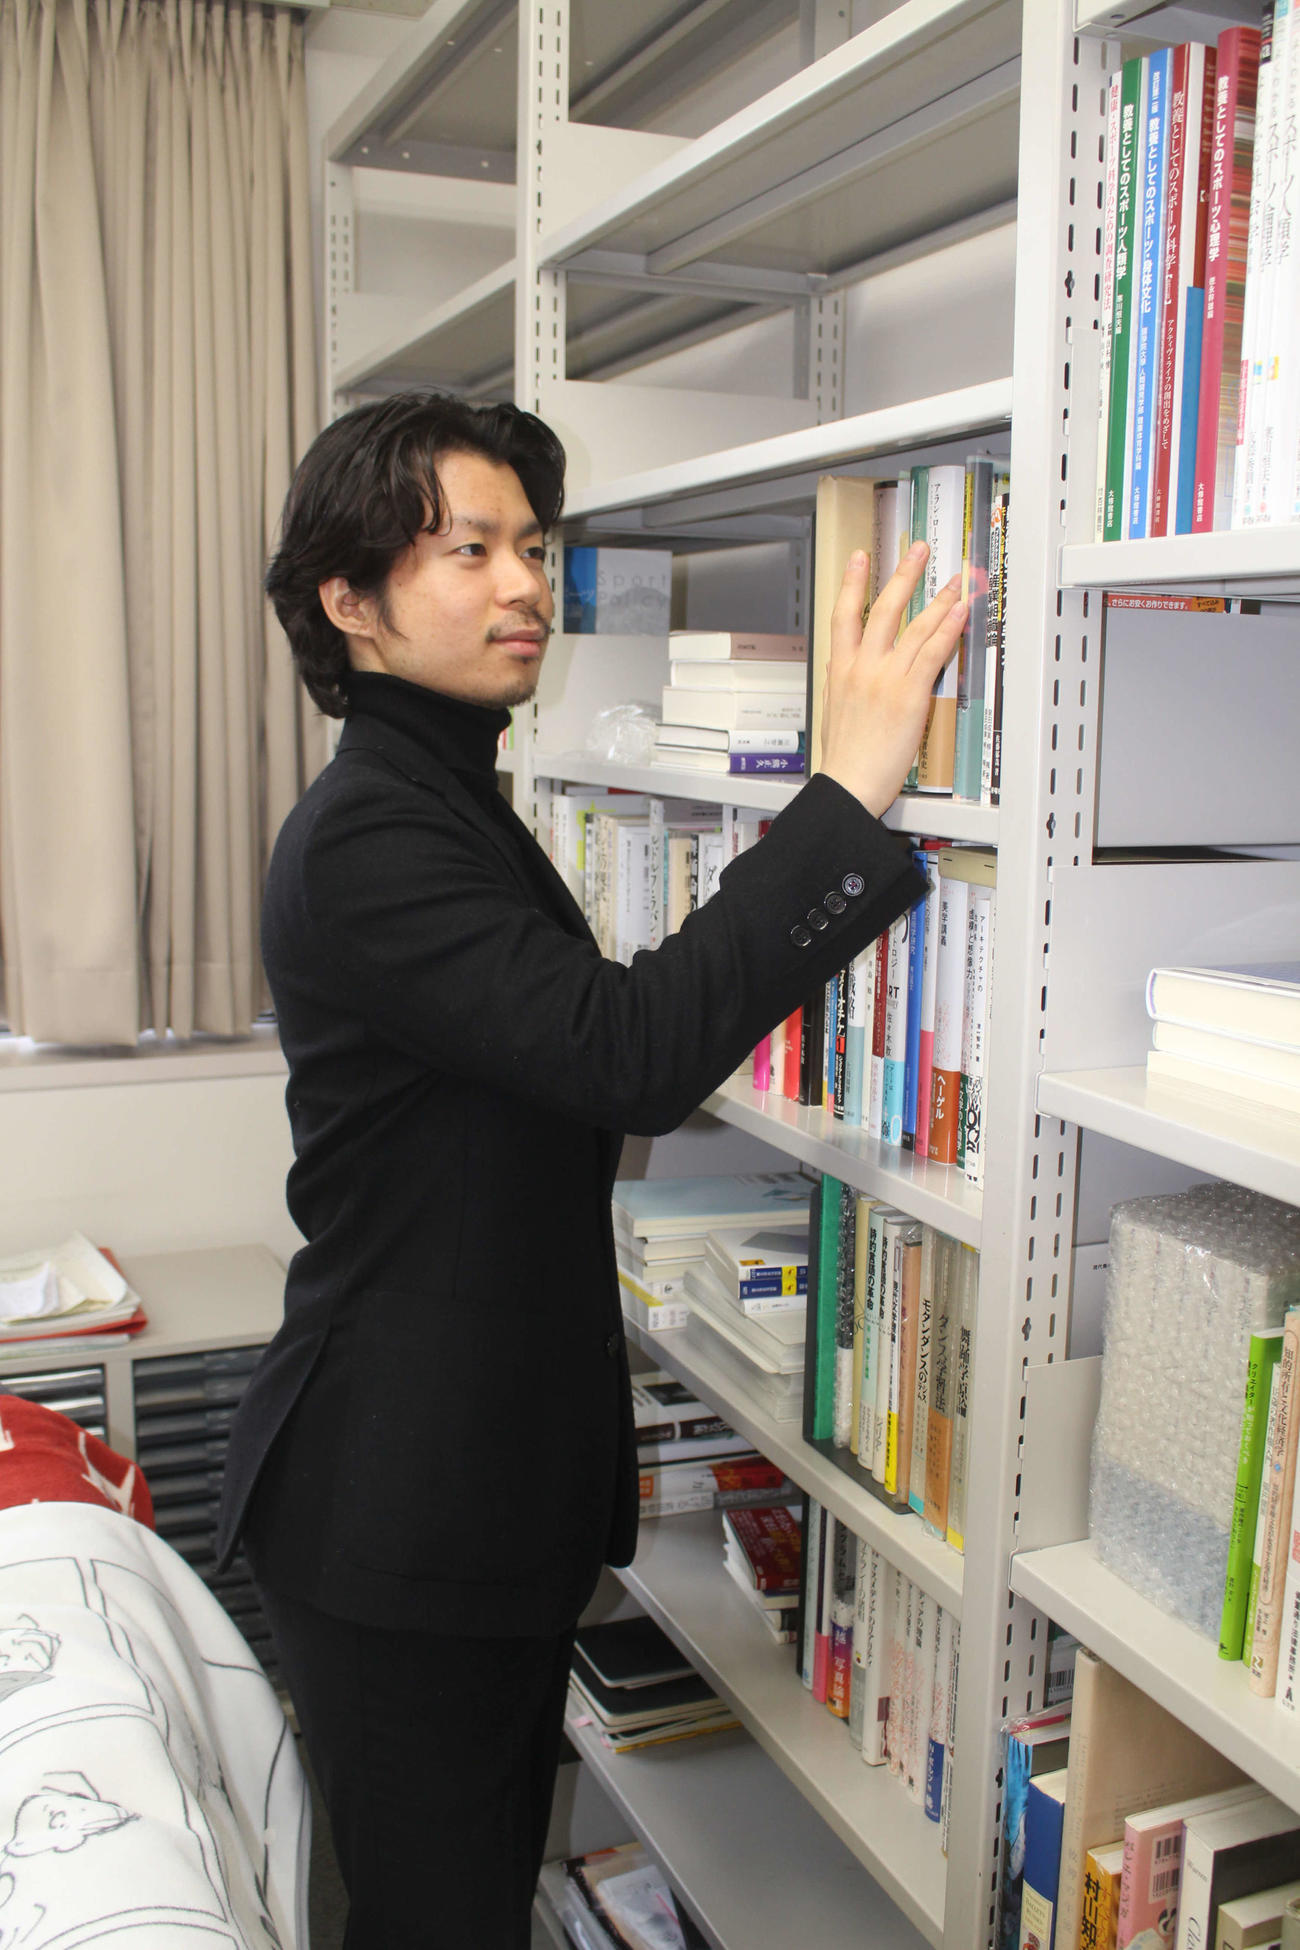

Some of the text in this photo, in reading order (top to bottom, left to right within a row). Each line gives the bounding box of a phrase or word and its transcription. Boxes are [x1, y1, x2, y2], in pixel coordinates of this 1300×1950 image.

[1116, 104, 1134, 280] 教養としてのスポーツ人類学
[1140, 120, 1161, 313] 教養としてのスポーツ・身体文化
[1164, 92, 1185, 271] 教養としてのスポーツ科学
[1209, 76, 1229, 262] 教養としてのスポーツ心理学
[929, 484, 941, 598] アラン・ローマックス選集
[1111, 598, 1189, 610] さらにお安くお作りできます。
[977, 915, 987, 992] アーキテクチャの
[935, 1073, 947, 1120] ヘーゲル
[1079, 1872, 1101, 1950] 村山知
